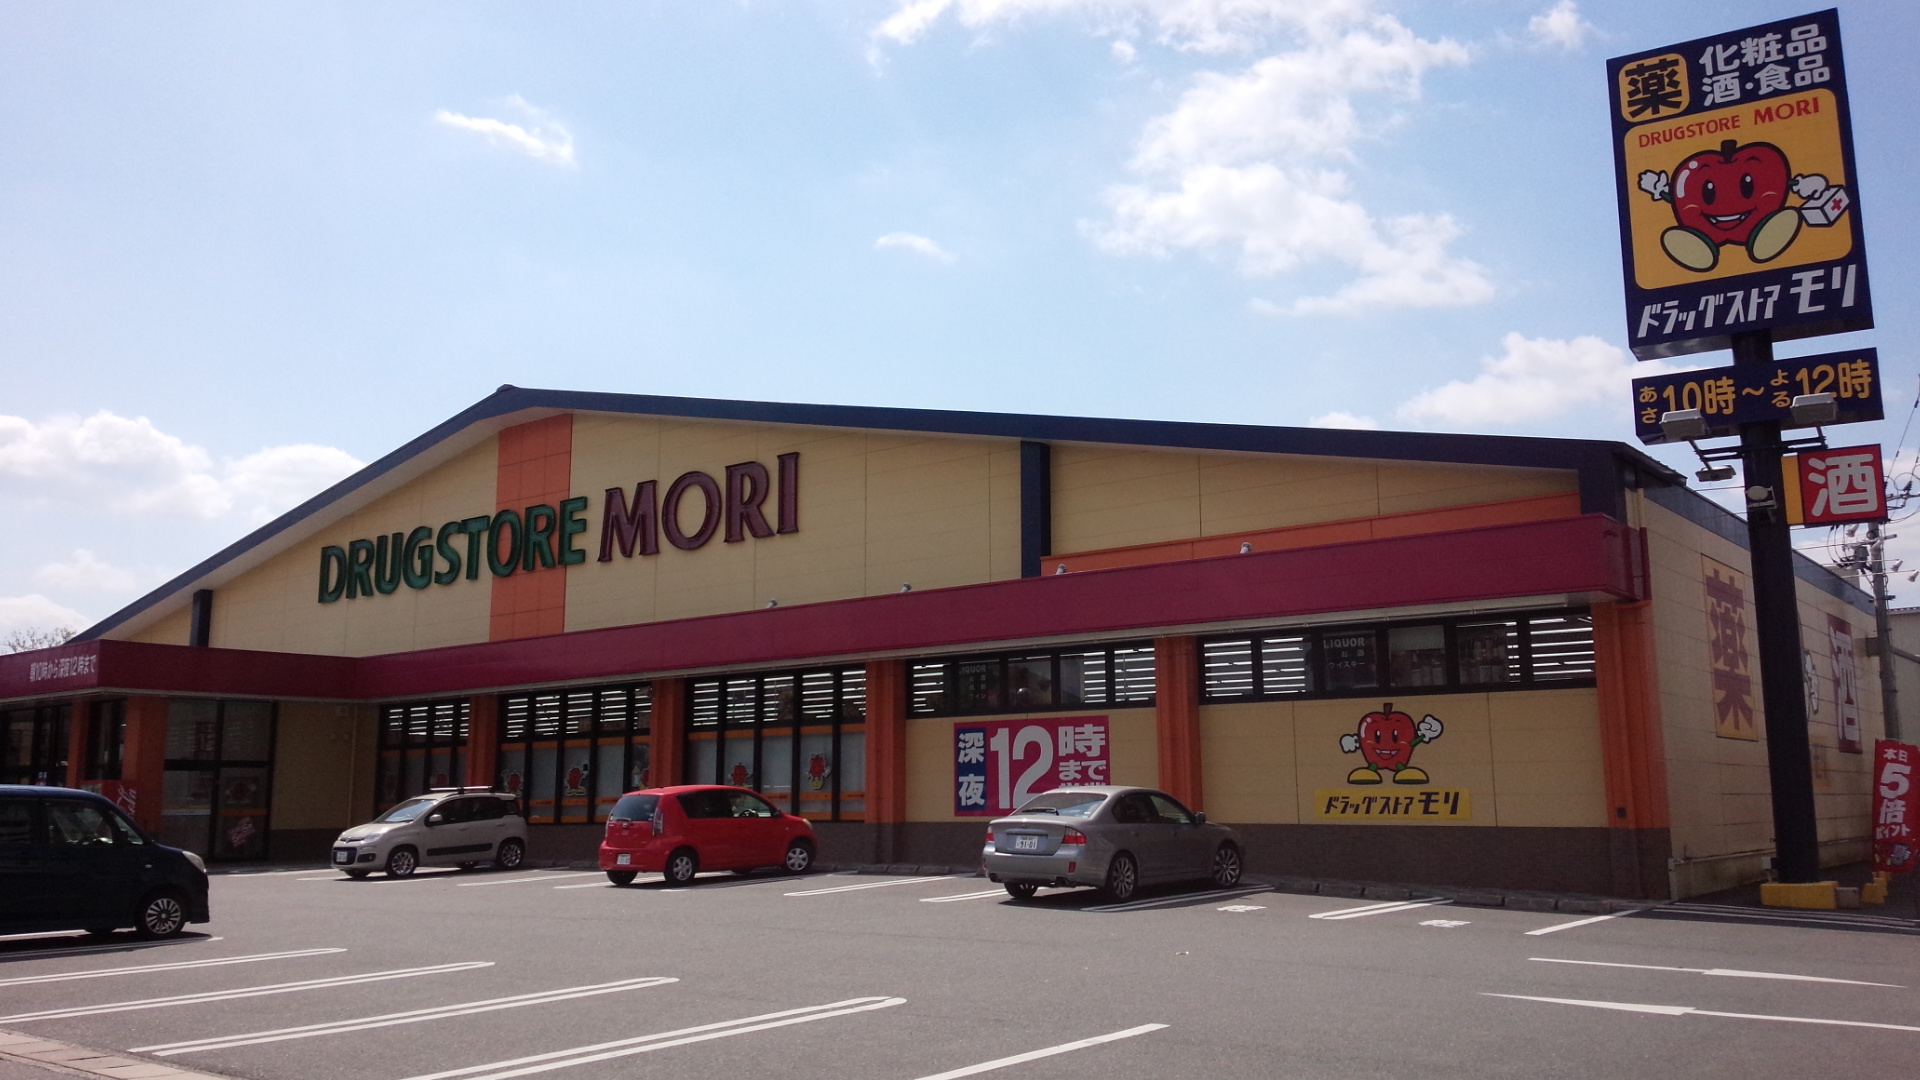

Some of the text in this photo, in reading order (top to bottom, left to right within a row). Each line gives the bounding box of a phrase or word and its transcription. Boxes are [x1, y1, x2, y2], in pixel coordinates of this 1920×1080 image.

[1698, 23, 1828, 76] 化粧品
[1624, 58, 1683, 118] 薬
[1638, 97, 1820, 148] DRUGSTORE MORI
[1807, 454, 1878, 516] 酒
[317, 451, 800, 604] DRUGSTORE MORI
[1323, 637, 1365, 649] LIQUOR
[1705, 568, 1754, 730] 薬
[1883, 748, 1908, 763] 本日
[1875, 823, 1912, 840] ポイント
